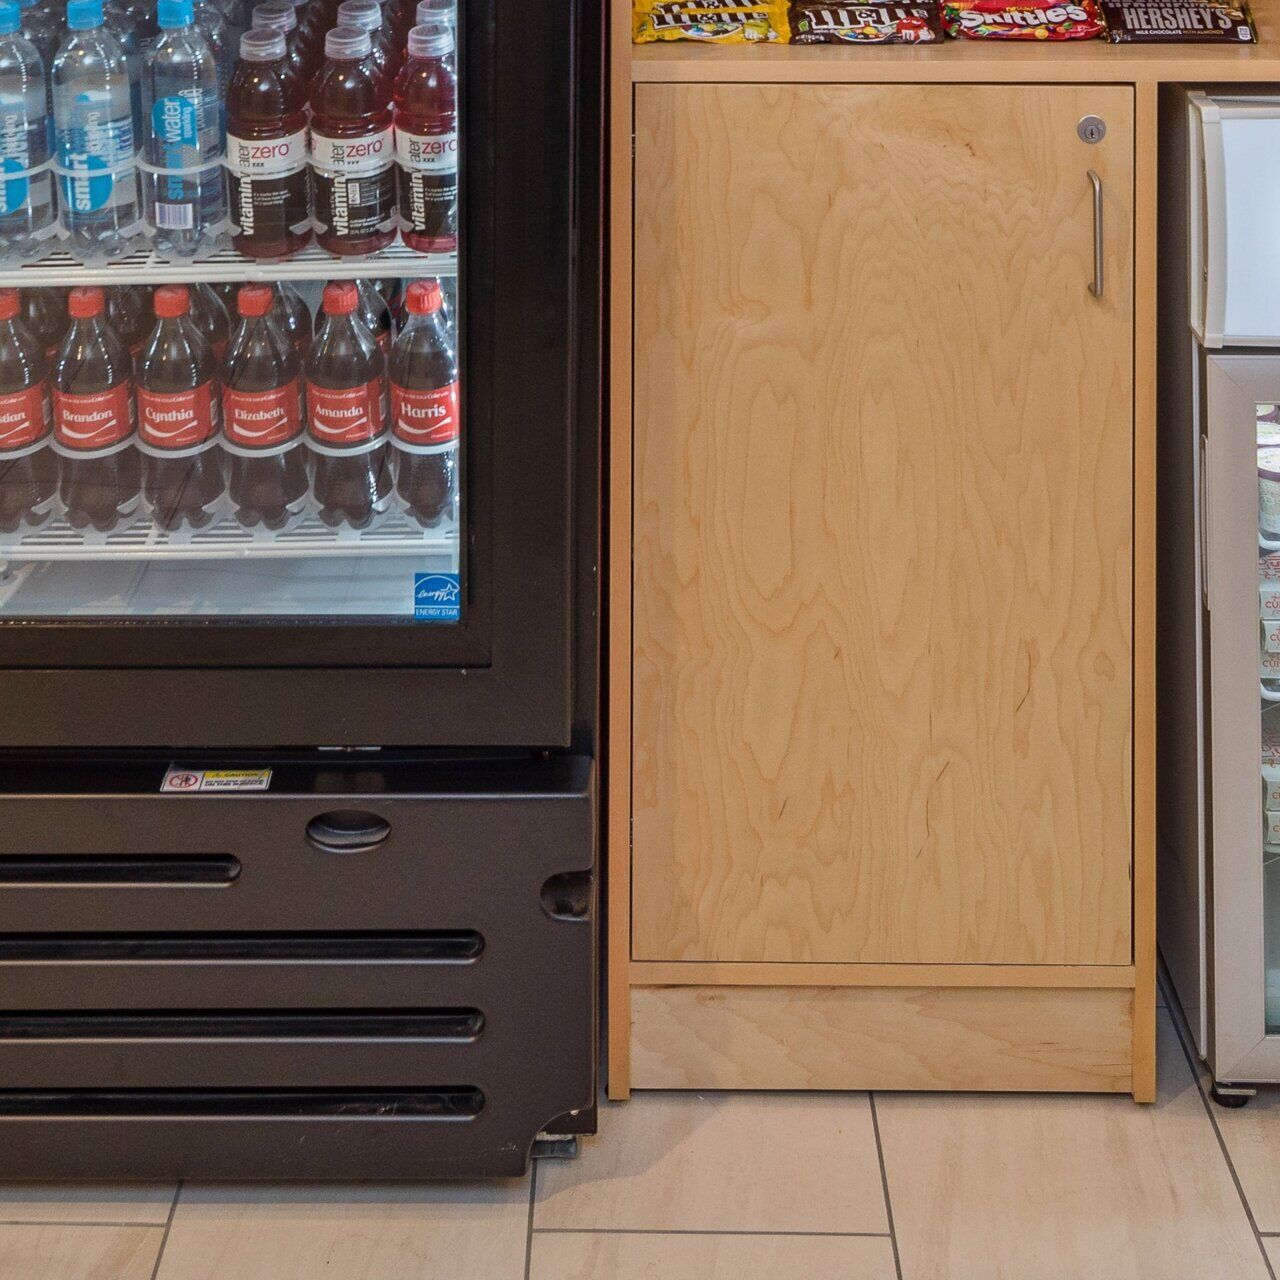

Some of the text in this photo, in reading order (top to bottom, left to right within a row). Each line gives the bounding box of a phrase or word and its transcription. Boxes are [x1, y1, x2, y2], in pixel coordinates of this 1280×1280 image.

[959, 5, 1088, 27] Skittles
[1123, 7, 1233, 30] HERSHEY'S
[251, 142, 293, 160] zero
[346, 138, 384, 158] zero
[62, 409, 113, 423] Brandon
[145, 407, 195, 423] Cynthia
[234, 406, 286, 421] Elizabeth
[315, 404, 364, 418] Amanda
[401, 402, 447, 418] Harris
[416, 608, 458, 616] ENERGY STAR
